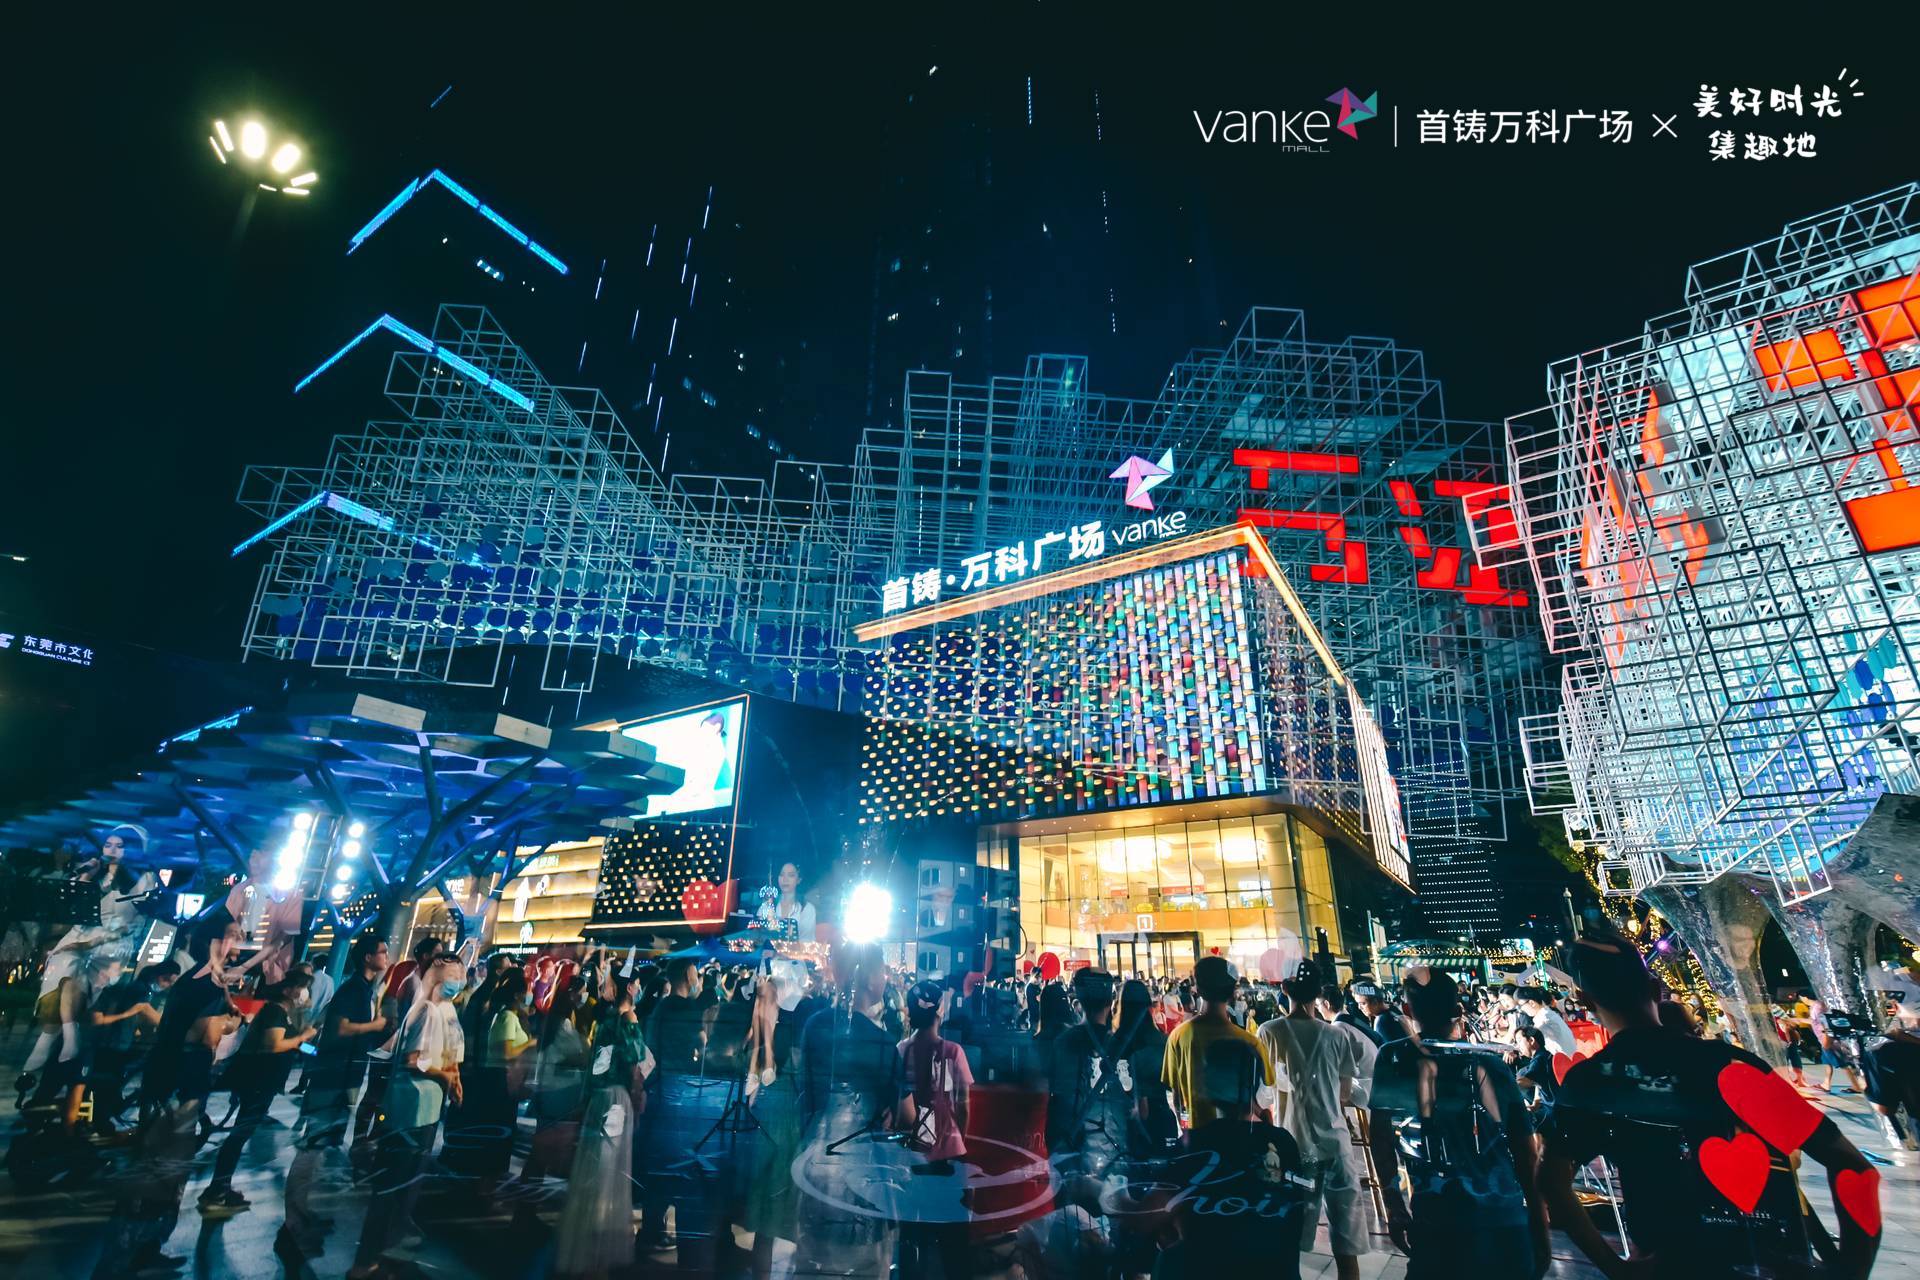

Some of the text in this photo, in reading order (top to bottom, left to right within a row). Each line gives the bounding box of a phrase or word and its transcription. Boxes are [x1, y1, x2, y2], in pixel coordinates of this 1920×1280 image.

[1111, 510, 1187, 546] vanke
[23, 635, 94, 660] 东莞市文化
